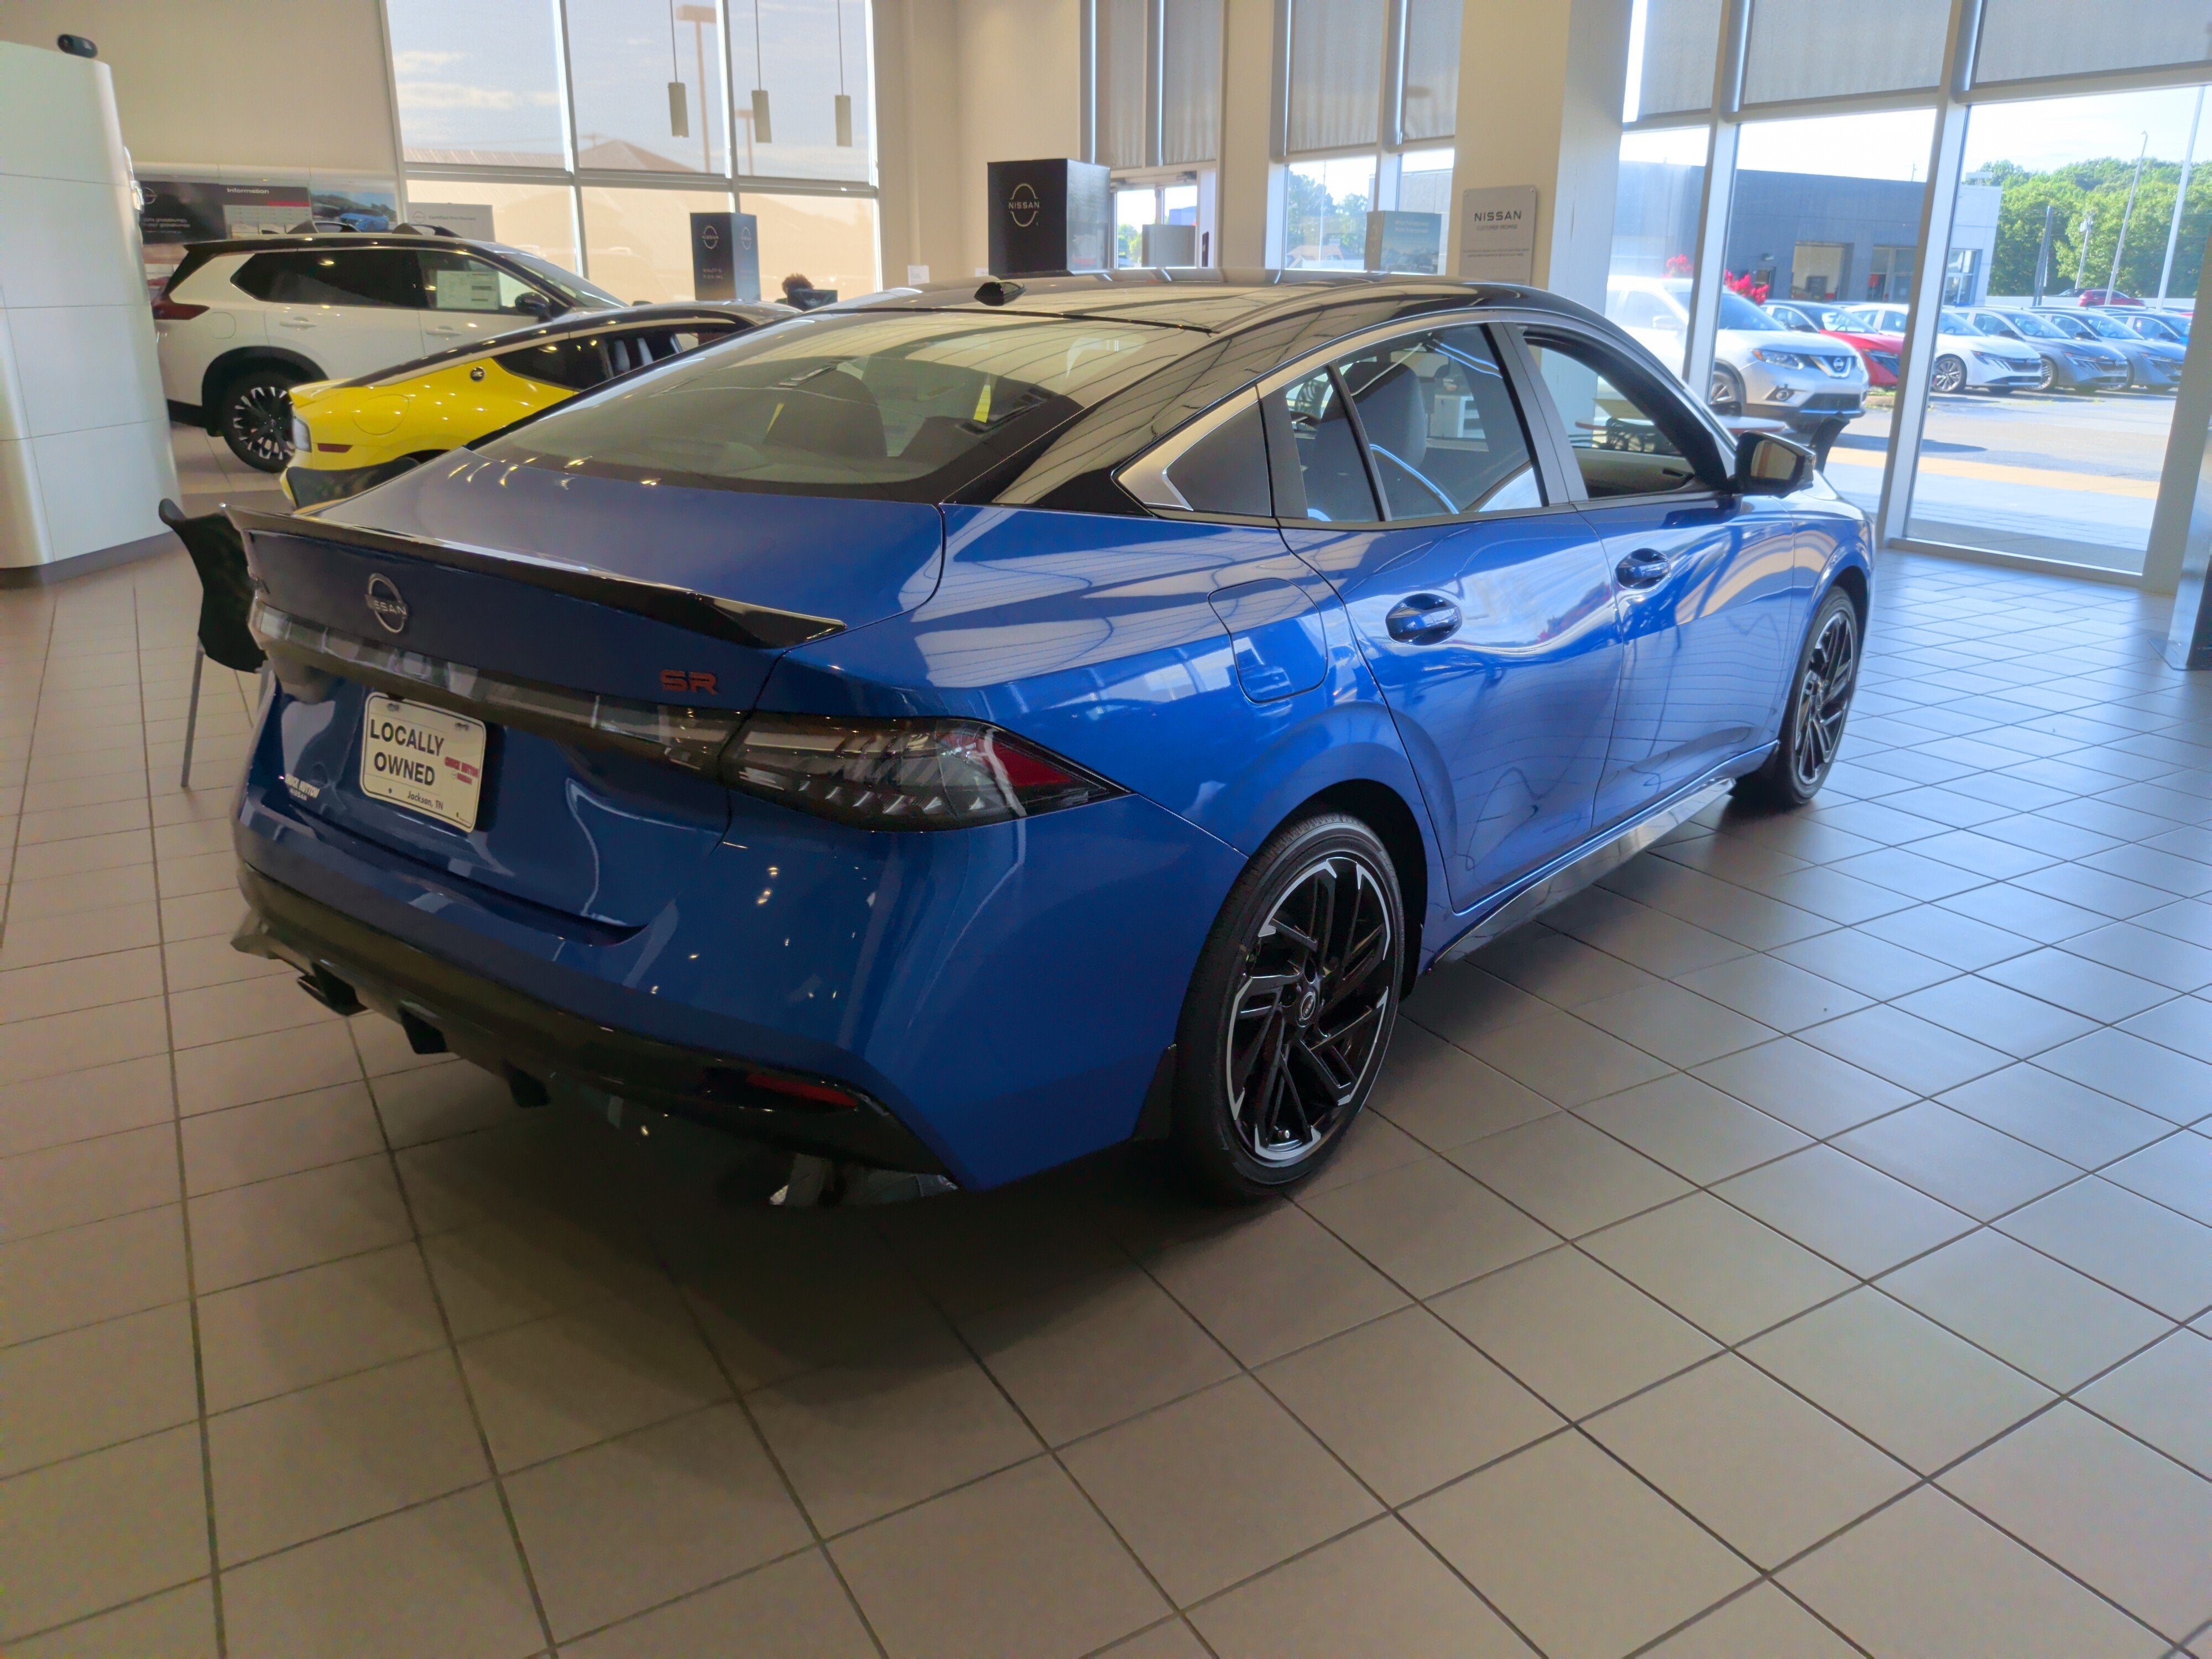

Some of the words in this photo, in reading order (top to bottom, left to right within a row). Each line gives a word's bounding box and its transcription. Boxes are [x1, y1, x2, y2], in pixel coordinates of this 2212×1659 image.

[1474, 210, 1522, 222] NISSAN
[661, 669, 718, 696] SR
[370, 719, 445, 757] LOCALLY
[374, 752, 435, 786] OWNED
[408, 791, 434, 808] Jackson,
[435, 800, 444, 810] TN
